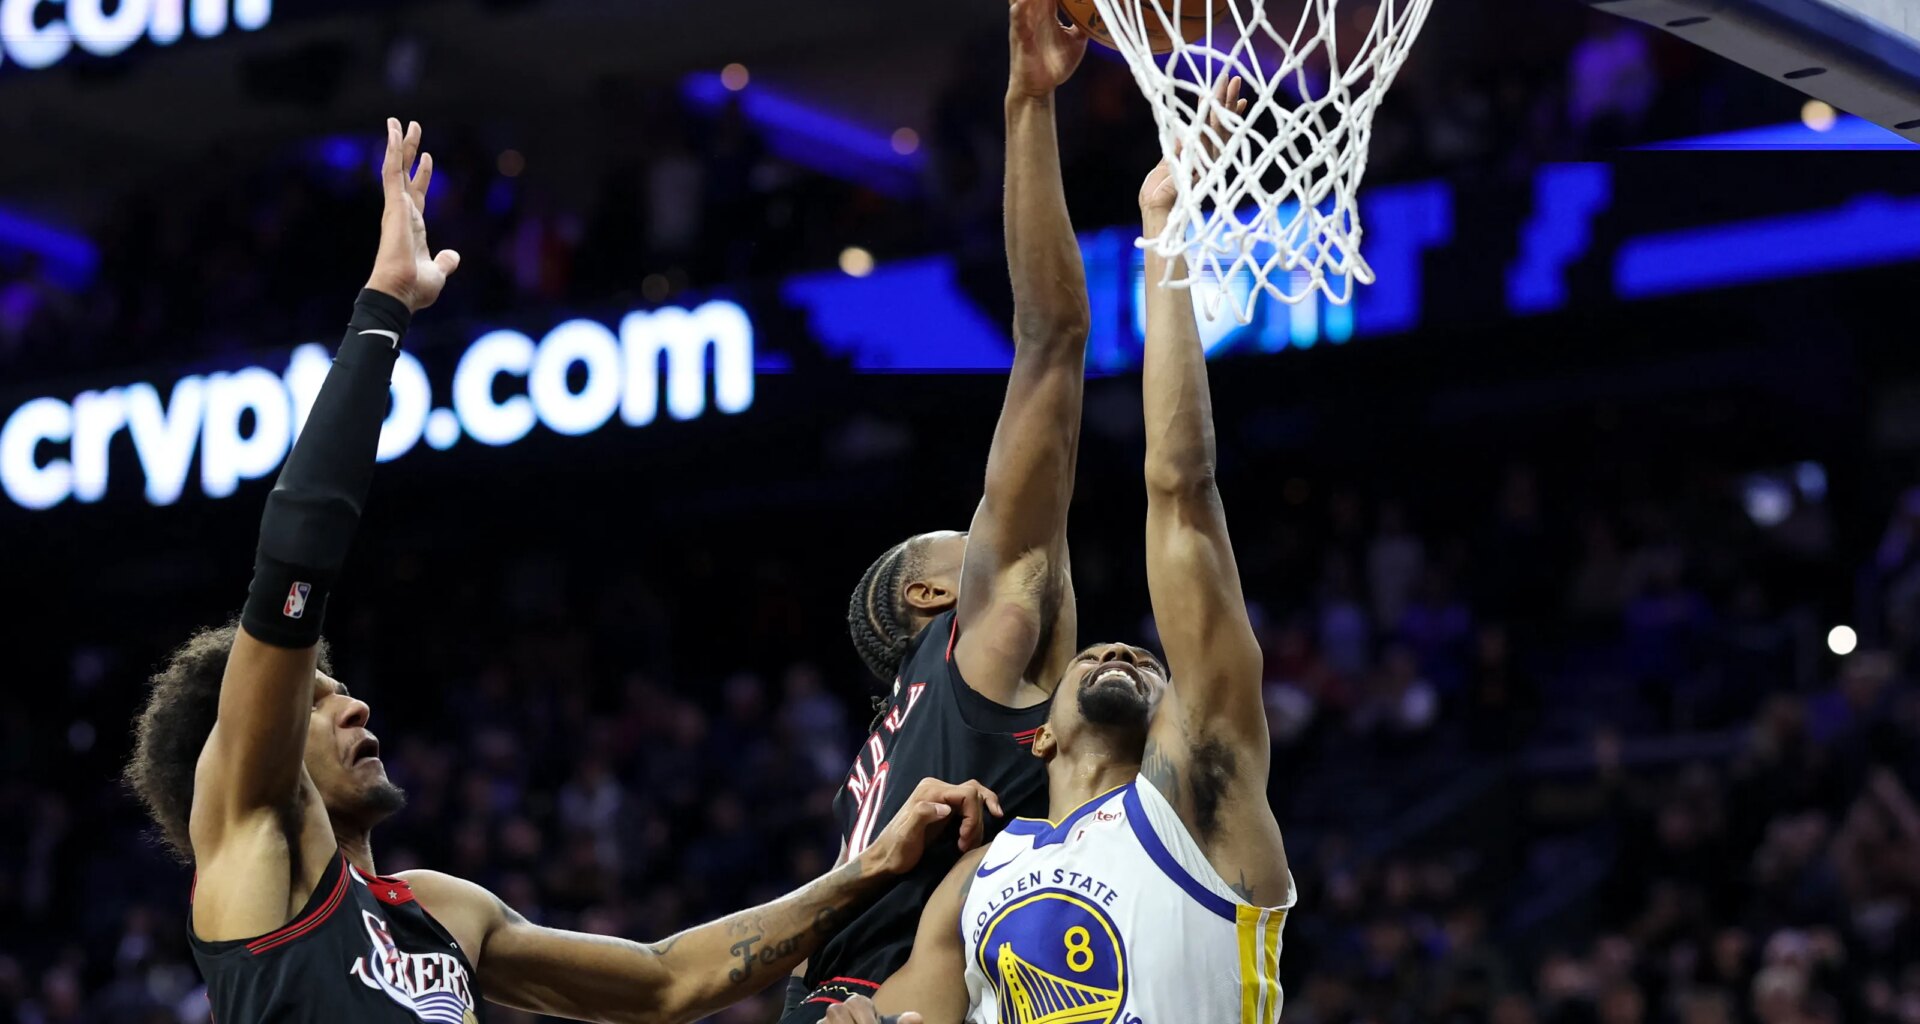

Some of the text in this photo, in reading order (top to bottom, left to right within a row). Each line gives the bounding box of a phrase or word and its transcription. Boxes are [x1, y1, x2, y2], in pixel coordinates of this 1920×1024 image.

[0, 299, 754, 509] crypto.com
[973, 868, 1118, 945] GOLDEN STATE
[1064, 925, 1095, 973] 8
